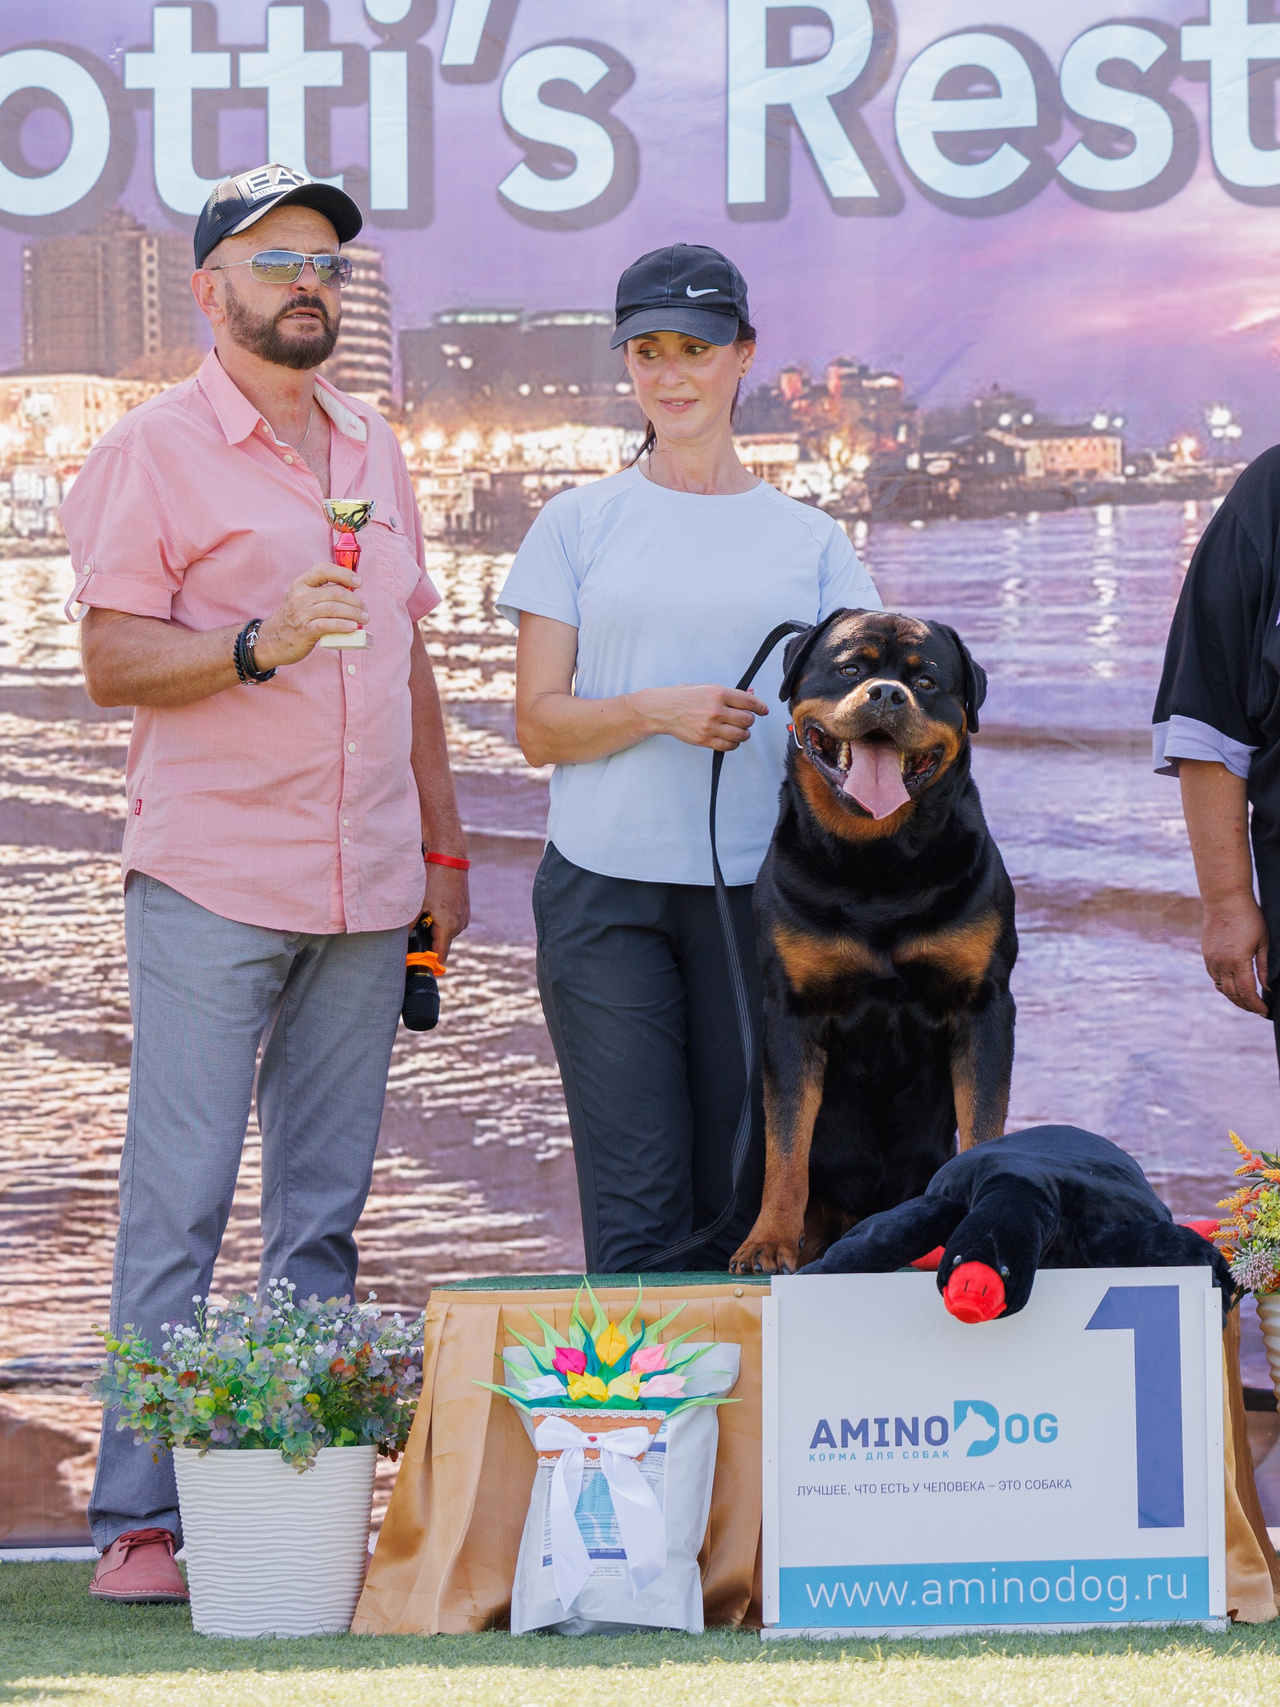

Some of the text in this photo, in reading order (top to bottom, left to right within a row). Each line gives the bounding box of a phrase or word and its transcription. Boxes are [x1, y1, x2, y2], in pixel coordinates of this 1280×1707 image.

[1084, 1285, 1185, 1529] 1
[809, 1450, 950, 1462] КОРМА ДЛЯ СОБАК
[797, 1485, 851, 1497] ЛУЧШЕЕ,
[854, 1484, 877, 1495] ЧТО
[880, 1483, 910, 1494] ЕСТЬ
[912, 1483, 921, 1493] У
[923, 1481, 986, 1493] ЧЕЛОВЕКА
[998, 1480, 1022, 1491] ЭТО
[1024, 1479, 1072, 1490] СОБАКА
[805, 1566, 1188, 1612] www.aminodog.ru
